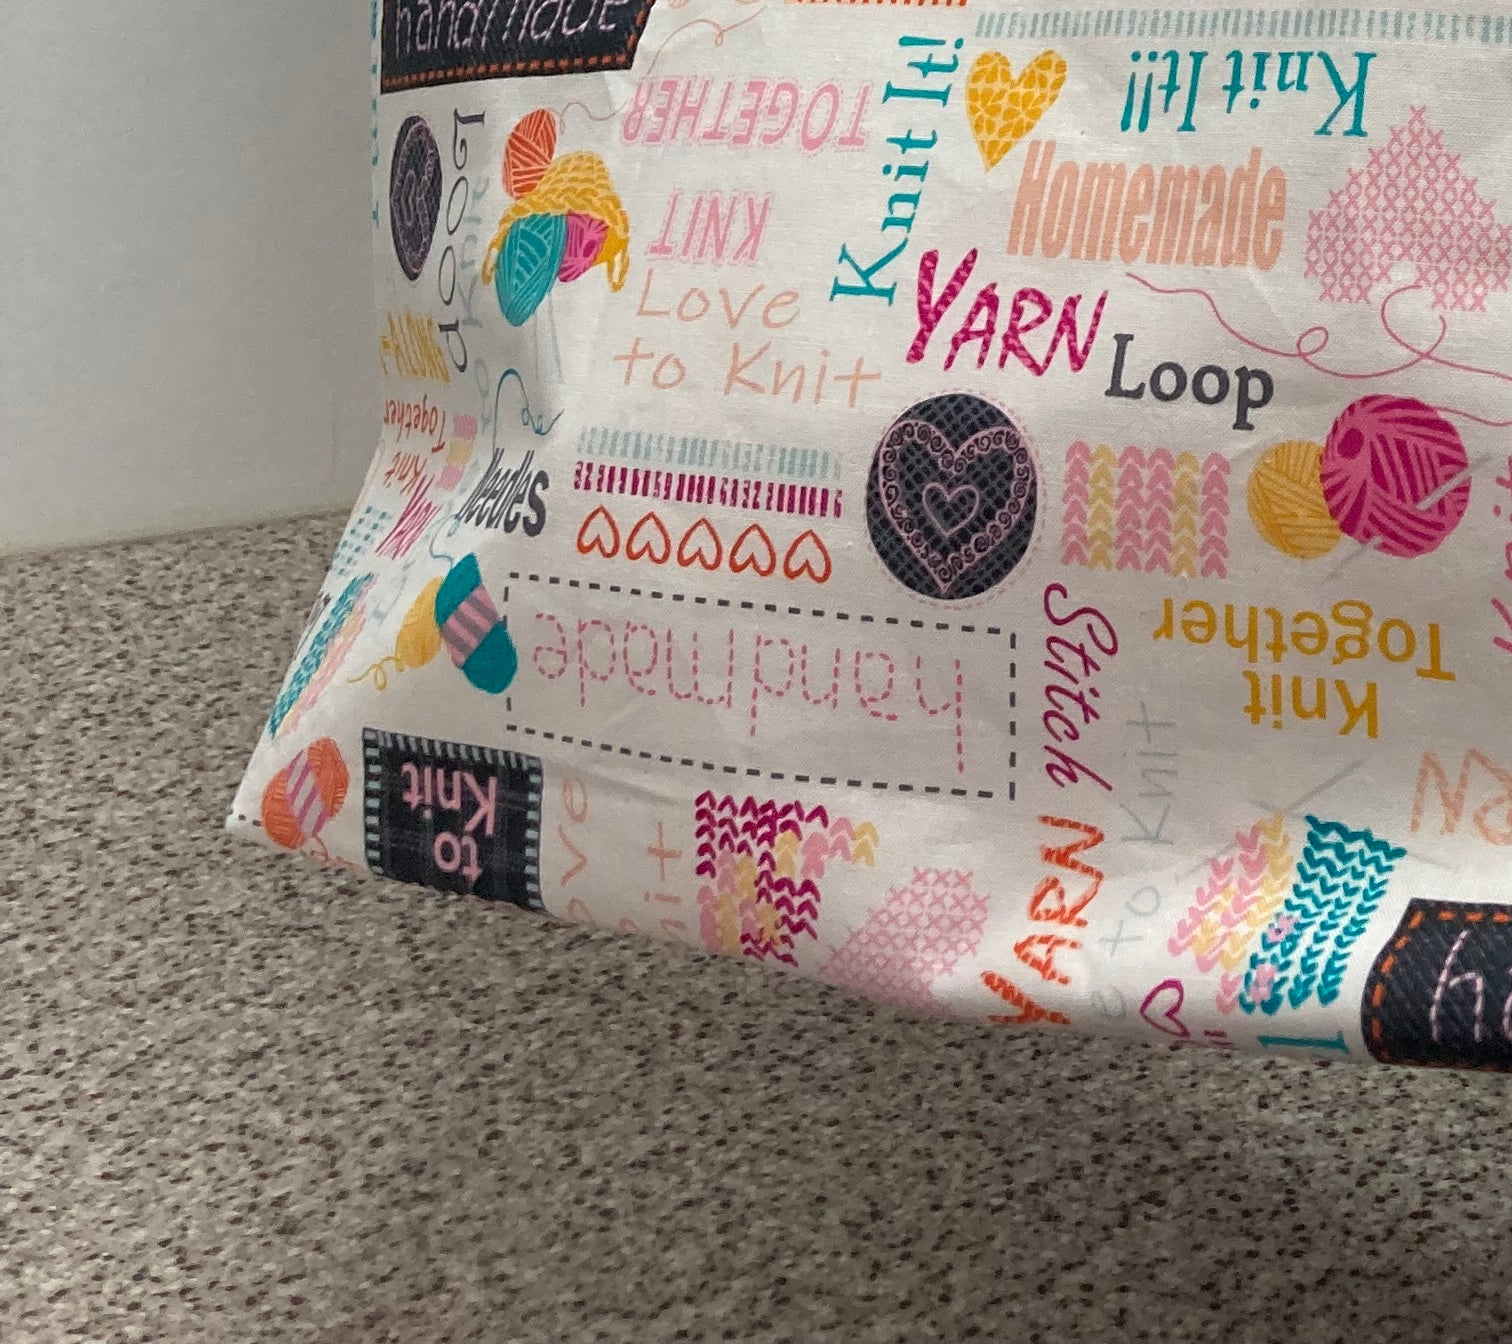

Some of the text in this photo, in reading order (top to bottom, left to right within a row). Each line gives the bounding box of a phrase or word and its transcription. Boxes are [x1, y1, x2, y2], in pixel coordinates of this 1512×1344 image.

[621, 78, 872, 151] TOGETHER
[1120, 49, 1377, 138] Knit It!!
[829, 34, 965, 307] Knit It!
[1006, 139, 1289, 271] Homemade
[438, 108, 486, 373] Loop
[646, 190, 770, 262] KNIT
[636, 268, 800, 329] Love
[905, 247, 1110, 378] YARN
[613, 336, 882, 409] to Knit
[1104, 332, 1275, 430] Loop
[1153, 598, 1456, 680] Together
[533, 612, 965, 774] handmade
[1043, 583, 1119, 791] Stitch
[1243, 669, 1379, 739] Knit
[402, 761, 498, 837] Knit
[1122, 702, 1178, 845] Knit
[433, 836, 483, 884] to
[980, 814, 1104, 1027] YARN
